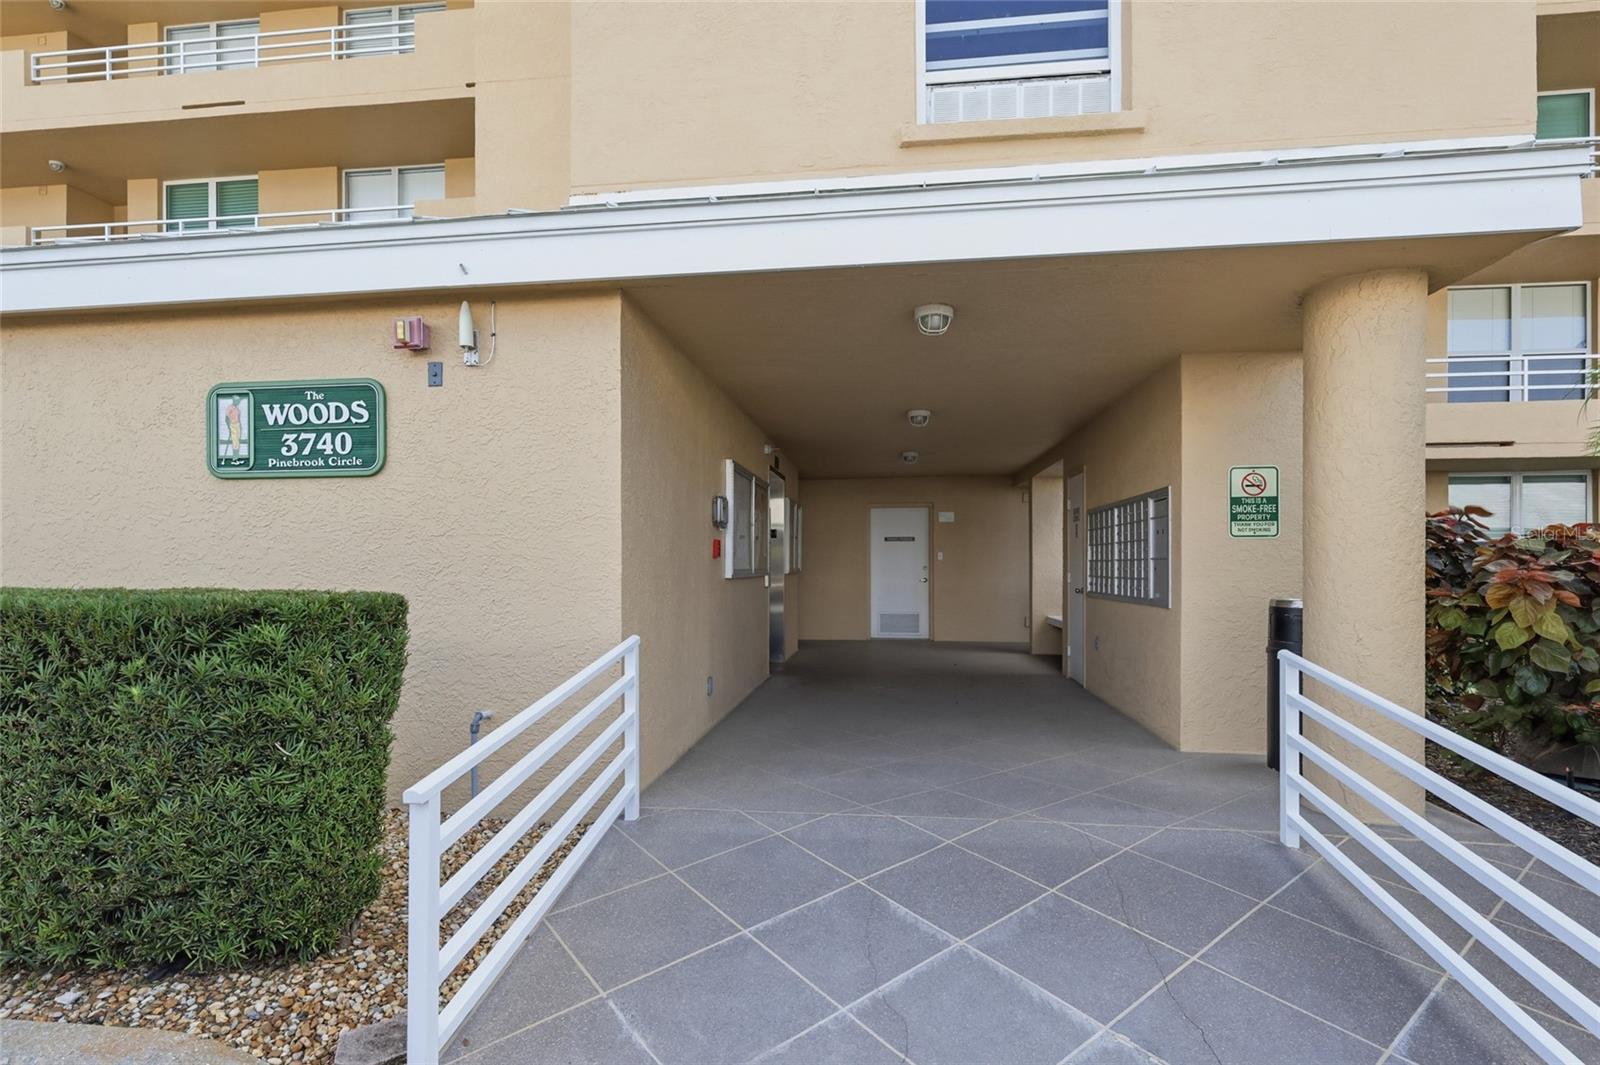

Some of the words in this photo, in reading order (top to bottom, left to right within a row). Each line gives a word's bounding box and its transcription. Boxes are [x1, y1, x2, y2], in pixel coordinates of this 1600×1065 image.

[304, 391, 325, 400] The
[261, 400, 370, 425] WOODS
[280, 432, 353, 456] 3740
[268, 456, 325, 467] Pinebrook
[328, 456, 363, 466] Circle
[1232, 505, 1276, 513] SMOKE-FREE
